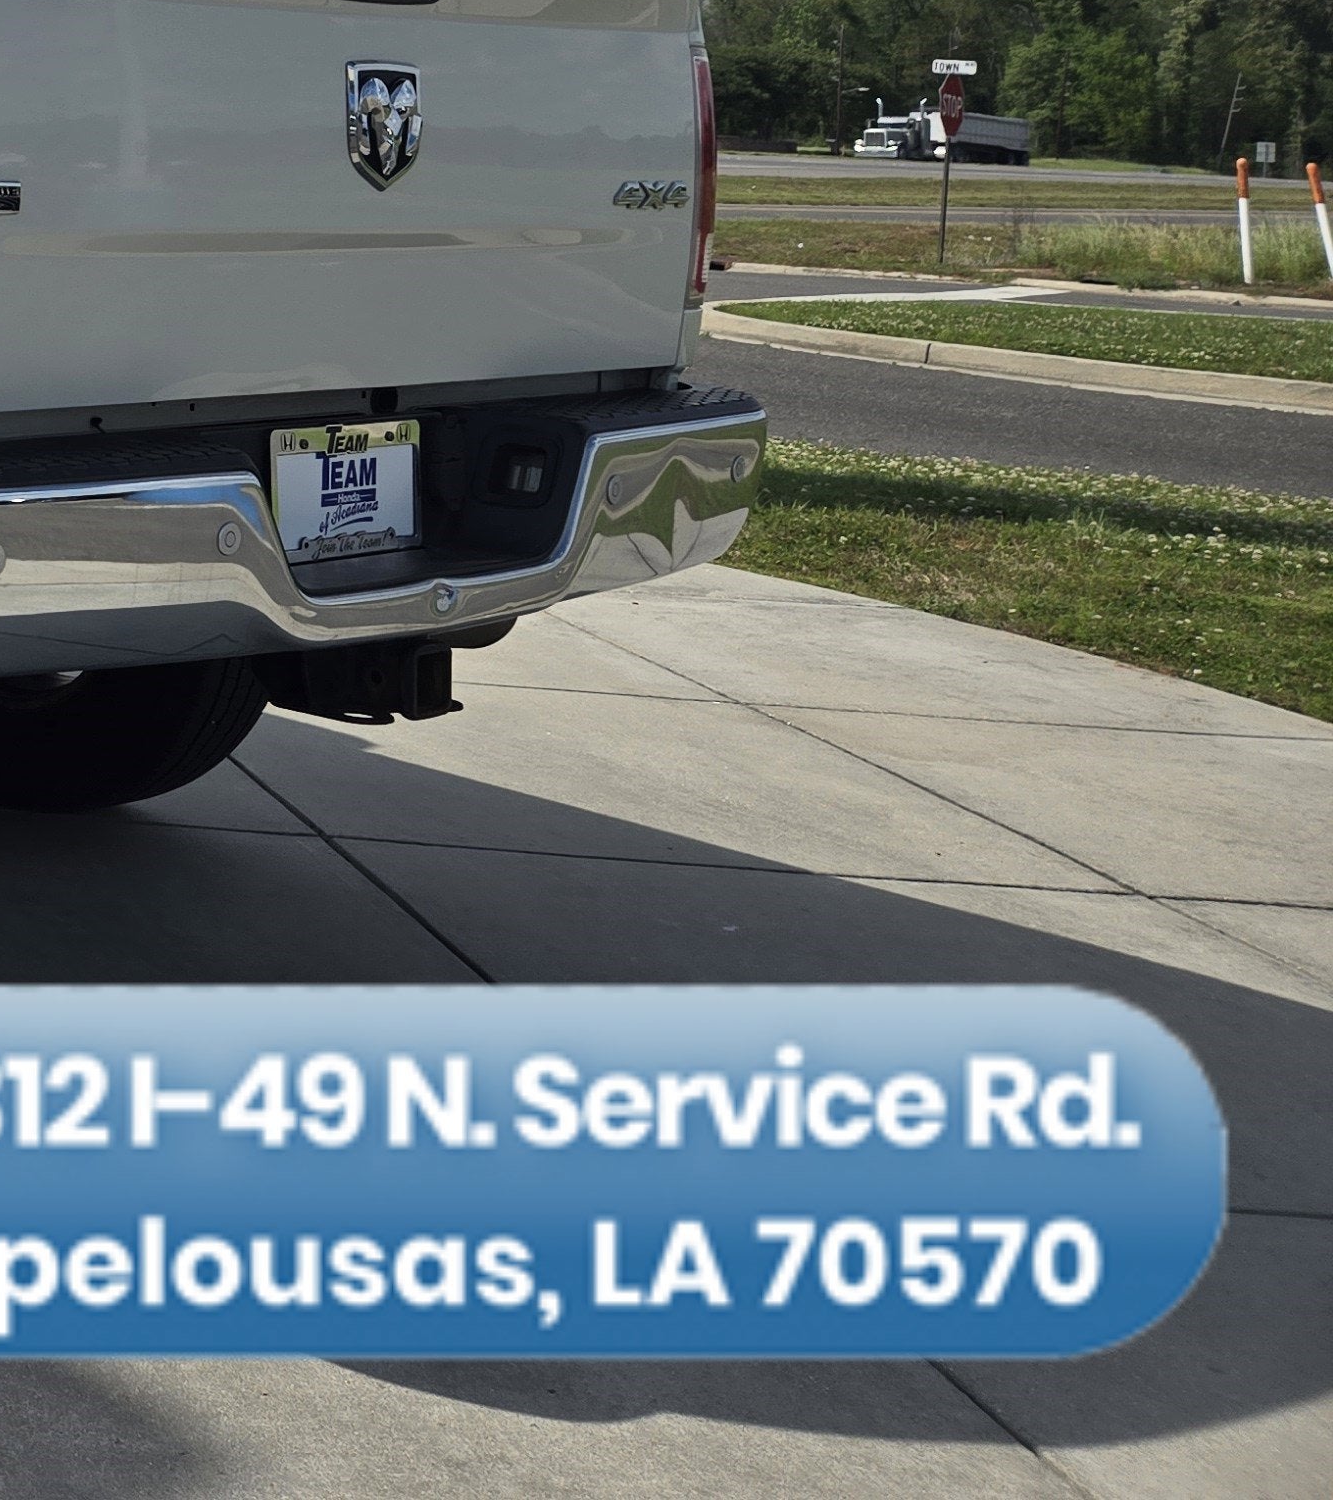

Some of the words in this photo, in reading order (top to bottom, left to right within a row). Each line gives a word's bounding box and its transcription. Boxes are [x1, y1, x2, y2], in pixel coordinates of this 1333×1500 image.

[942, 93, 963, 118] STOP
[325, 425, 369, 454] TEAM
[315, 451, 377, 490] TEAM
[337, 492, 361, 503] Honda
[319, 512, 330, 535] of
[330, 500, 379, 526] Acadiana
[312, 537, 336, 560] Join
[337, 535, 354, 552] The
